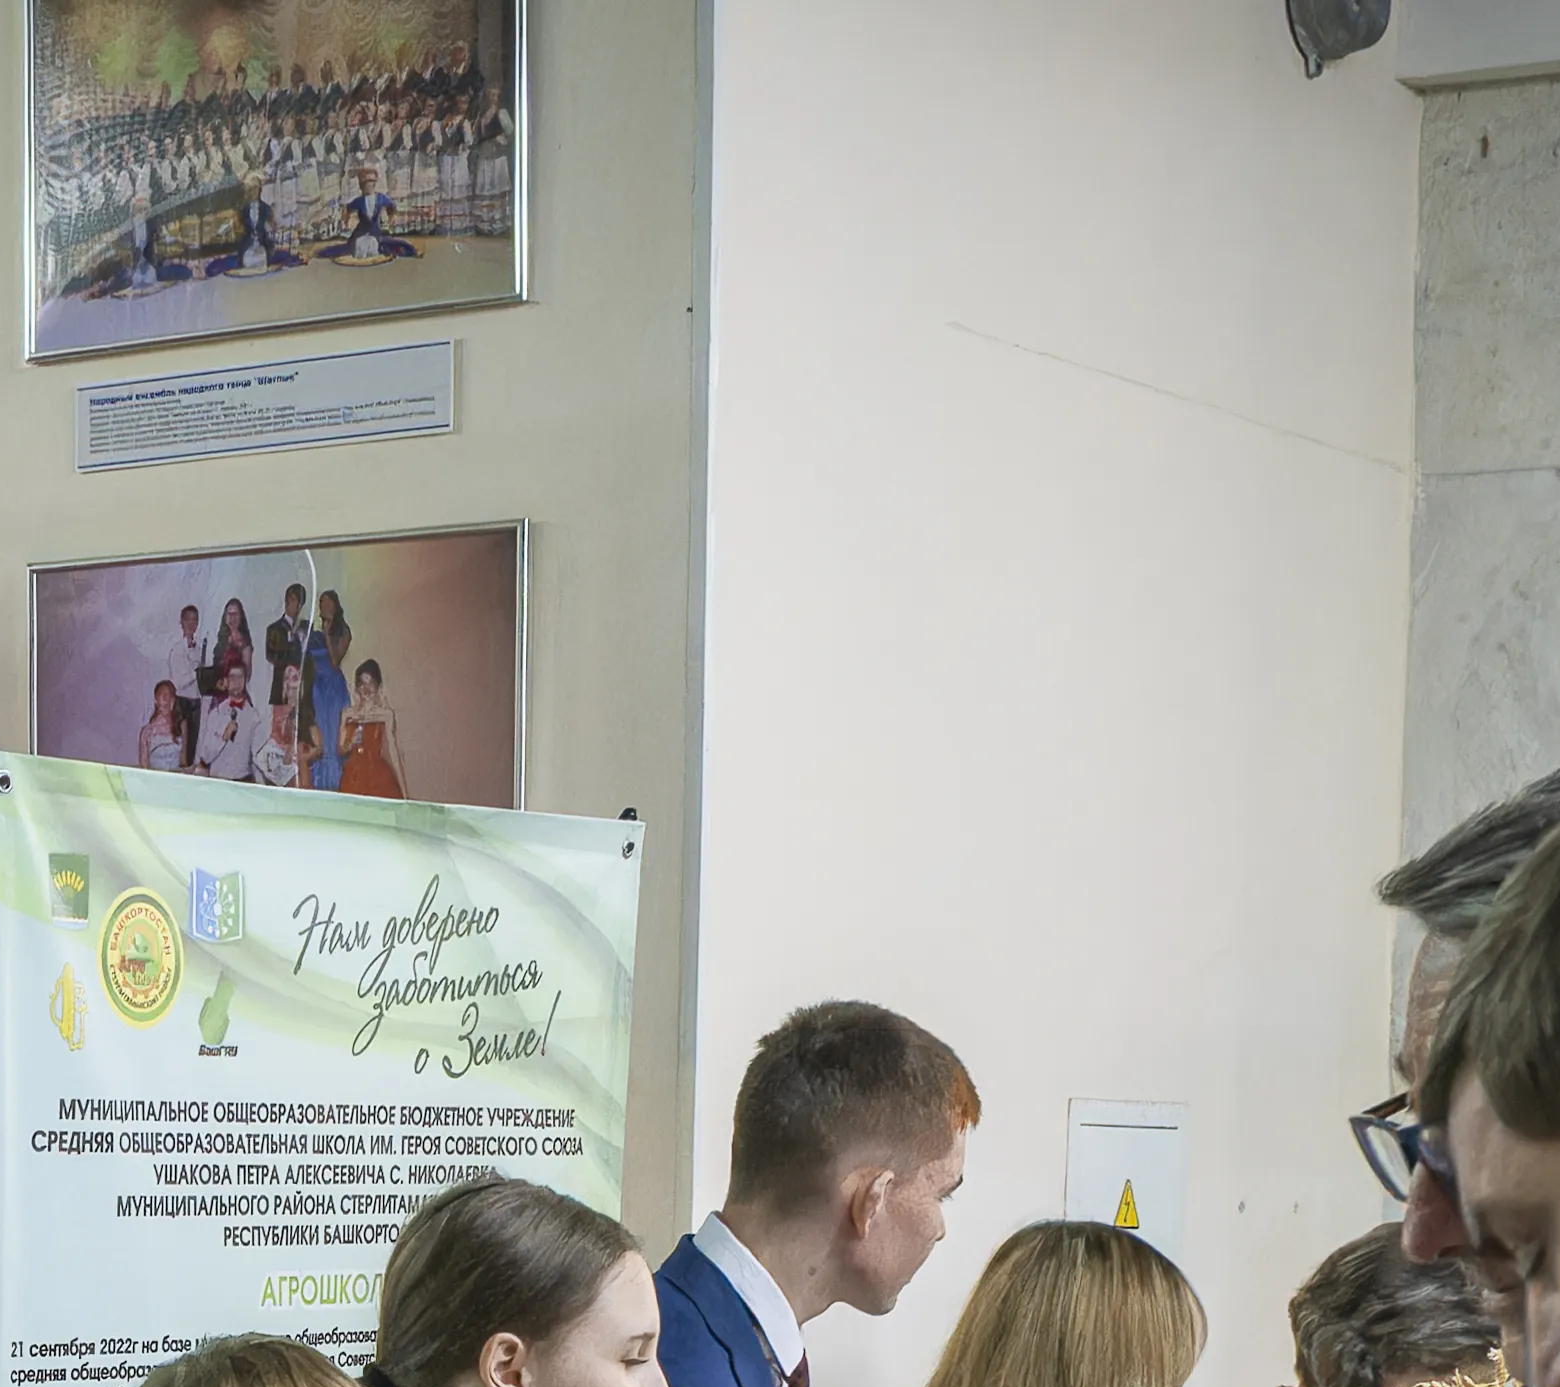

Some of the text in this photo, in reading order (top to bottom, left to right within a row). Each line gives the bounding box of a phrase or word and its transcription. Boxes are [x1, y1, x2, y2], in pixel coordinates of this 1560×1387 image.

[292, 874, 500, 998] Нам доверено
[352, 955, 543, 1056] заботиться
[414, 990, 562, 1079] о Земле!
[58, 1097, 576, 1129] МУНИЦИПАЛЬНОЕ ОБЩЕОБРАЗОВАТЕЛЬНОЕ БЮДЖЕТНОЕ УЧРЕЖДЕНИЕ
[31, 1128, 584, 1157] СРЕДНЯЯ ОБЩЕОБРАЗОВАТЕЛЬНАЯ ШКОЛА ИМ. ГЕРОЯ СОВЕТСКОГО СОЮЗА
[153, 1163, 386, 1187] УШАКОВА ПЕТРА АЛЕКСЕЕВИЧА
[116, 1190, 336, 1219] МУНИЦИПАЛЬНОГО РАЙОНА
[223, 1223, 400, 1247] РЕСПУБЛИКИ БАШКОРТО
[28, 1335, 192, 1360] сентября 2022г на базе
[10, 1365, 67, 1385] средняя
